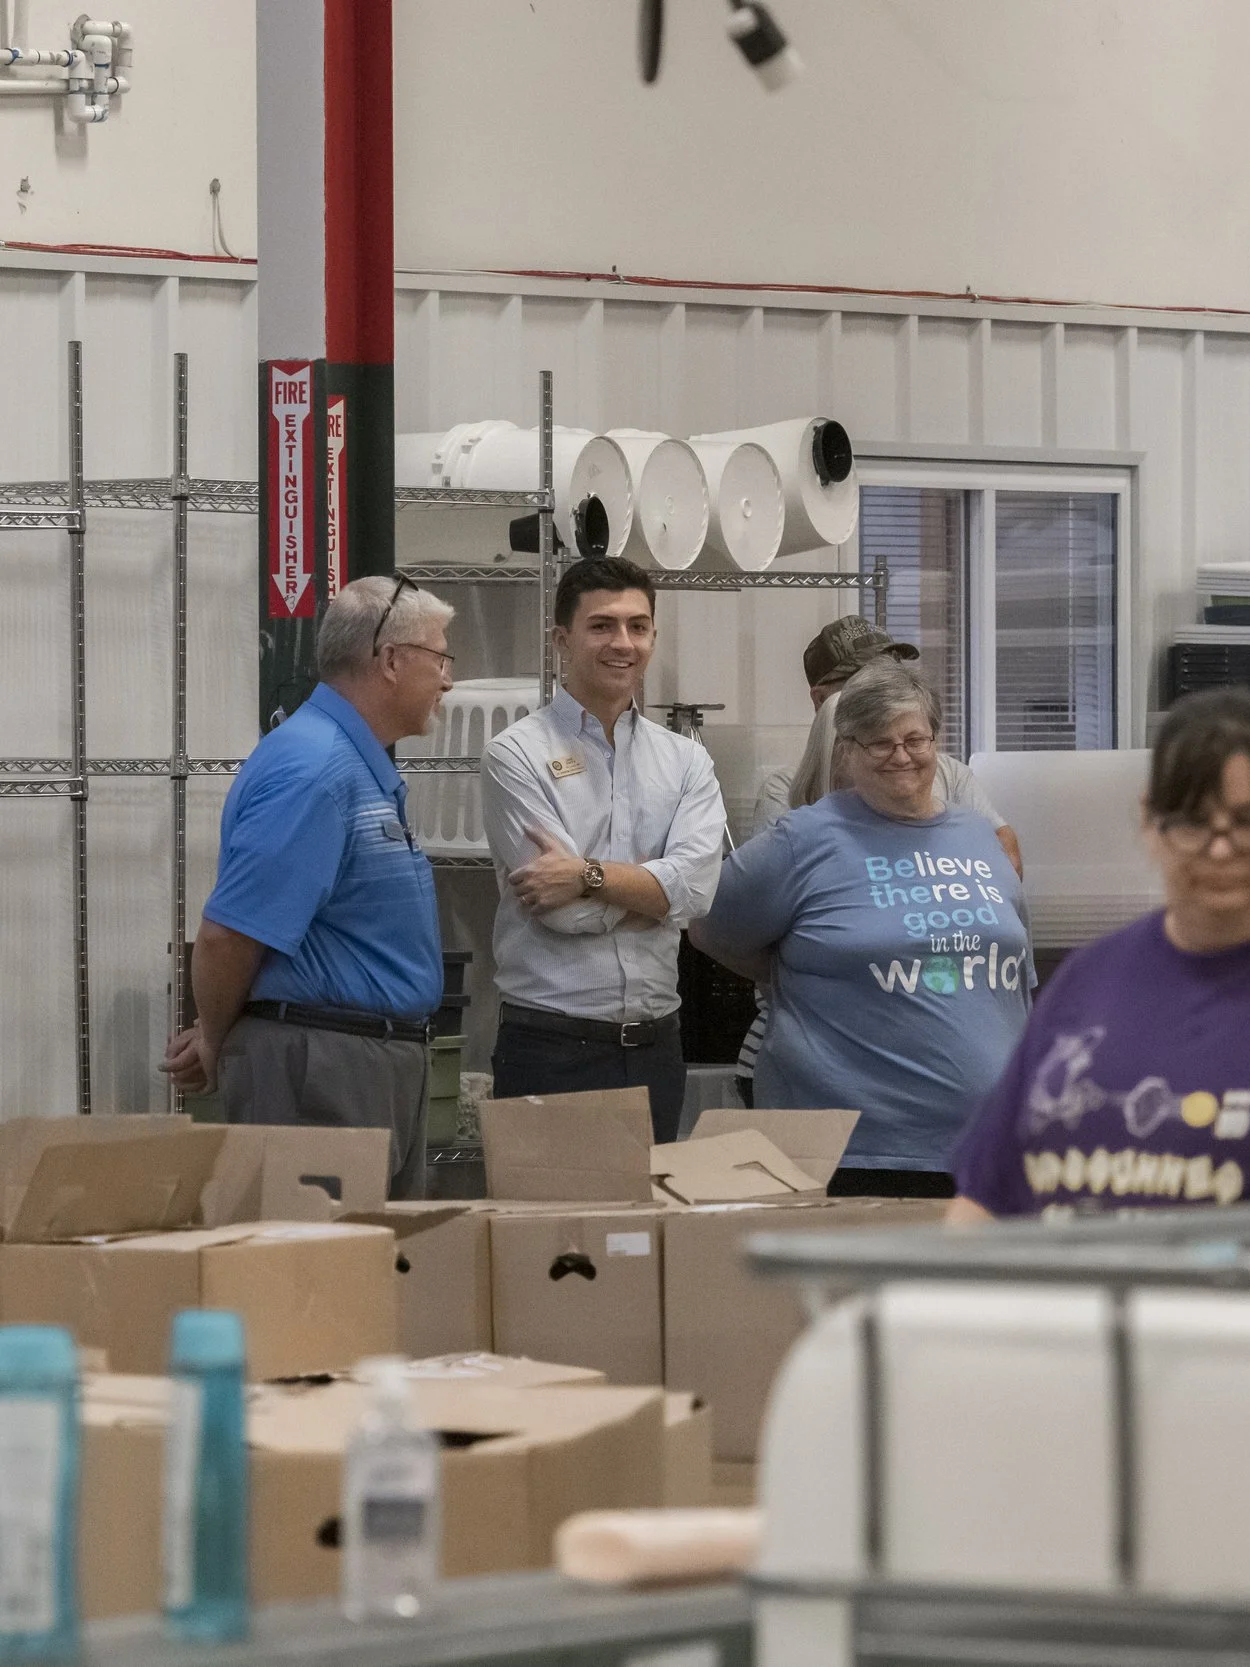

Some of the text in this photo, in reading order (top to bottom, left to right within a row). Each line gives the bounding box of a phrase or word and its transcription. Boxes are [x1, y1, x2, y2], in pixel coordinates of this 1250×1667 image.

[275, 381, 307, 404] FIRE
[328, 415, 342, 438] RE
[285, 415, 298, 594] EXTINGUISHER
[328, 448, 337, 600] EXTINGUISH
[865, 851, 993, 882] Believe
[870, 879, 1004, 909] there is
[903, 902, 999, 938] good
[930, 930, 981, 953] in the
